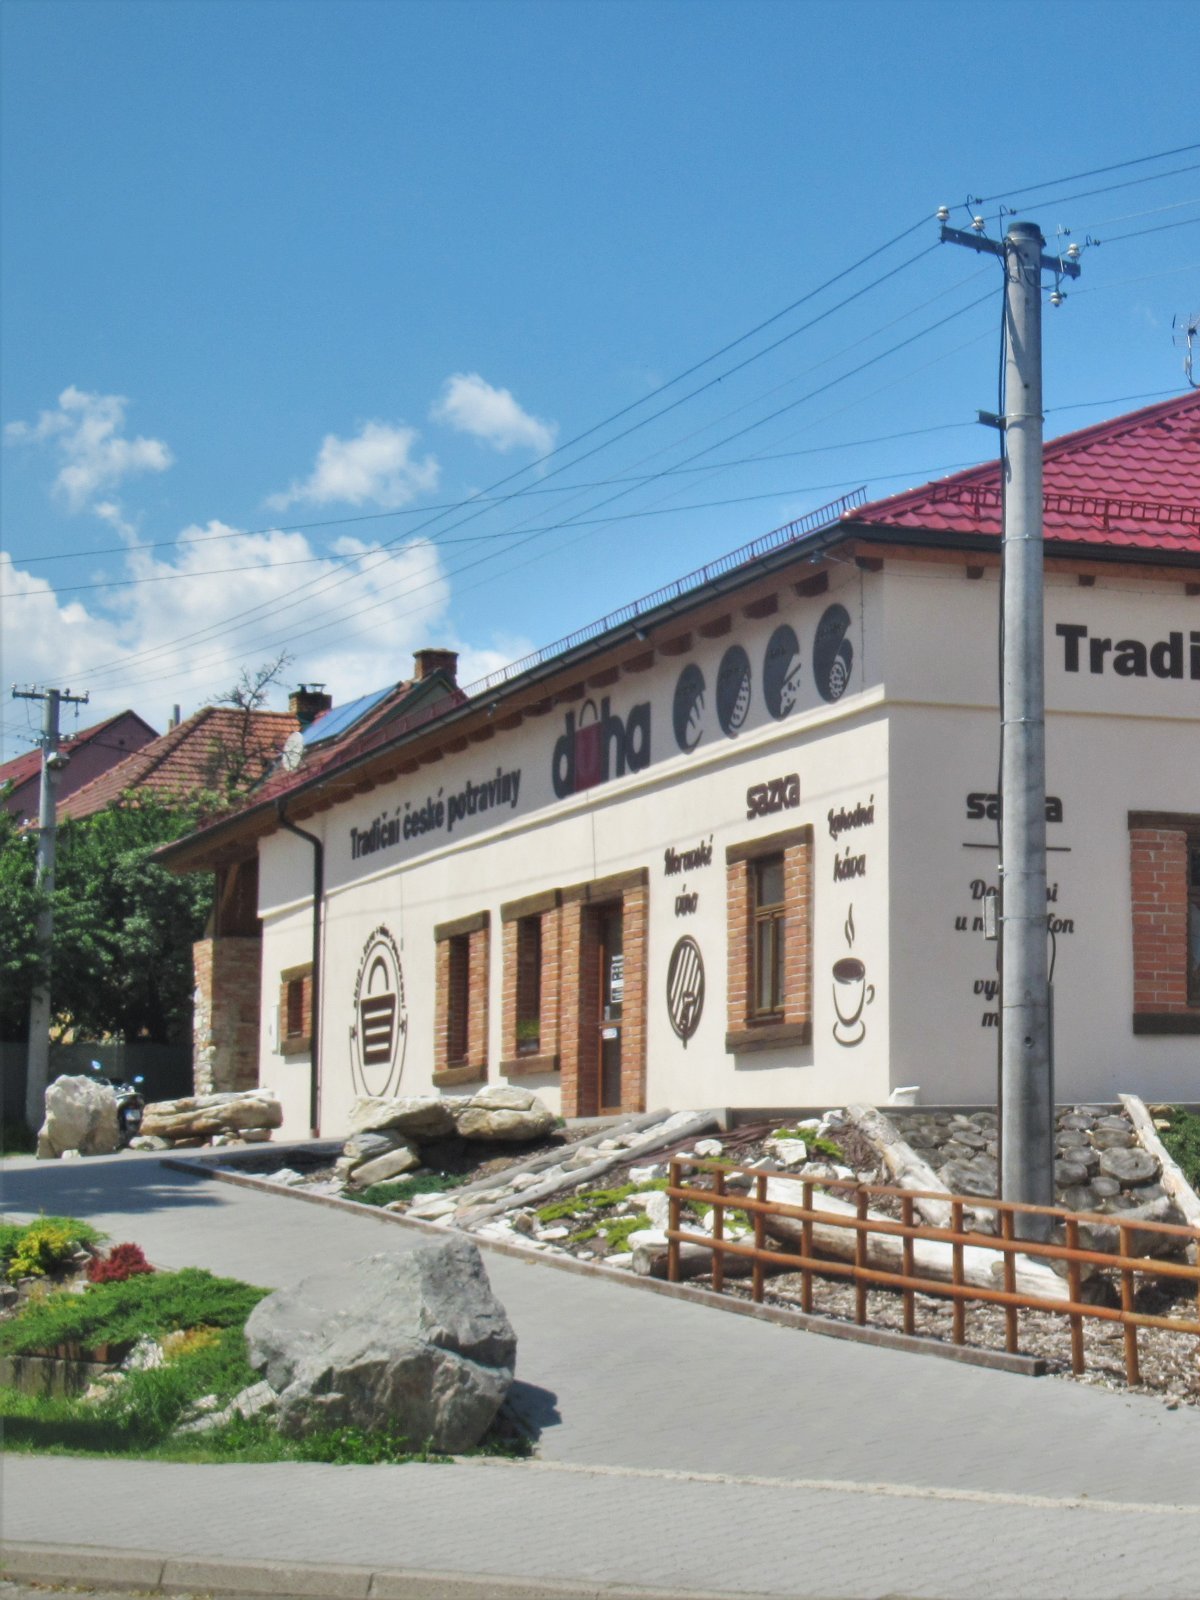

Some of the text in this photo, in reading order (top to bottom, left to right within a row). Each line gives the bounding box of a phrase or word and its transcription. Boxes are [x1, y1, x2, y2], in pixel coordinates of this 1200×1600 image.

[552, 696, 651, 799] duha
[350, 766, 521, 860] Tradiční české potraviny
[966, 793, 1063, 822] saa
[833, 846, 867, 882] káva
